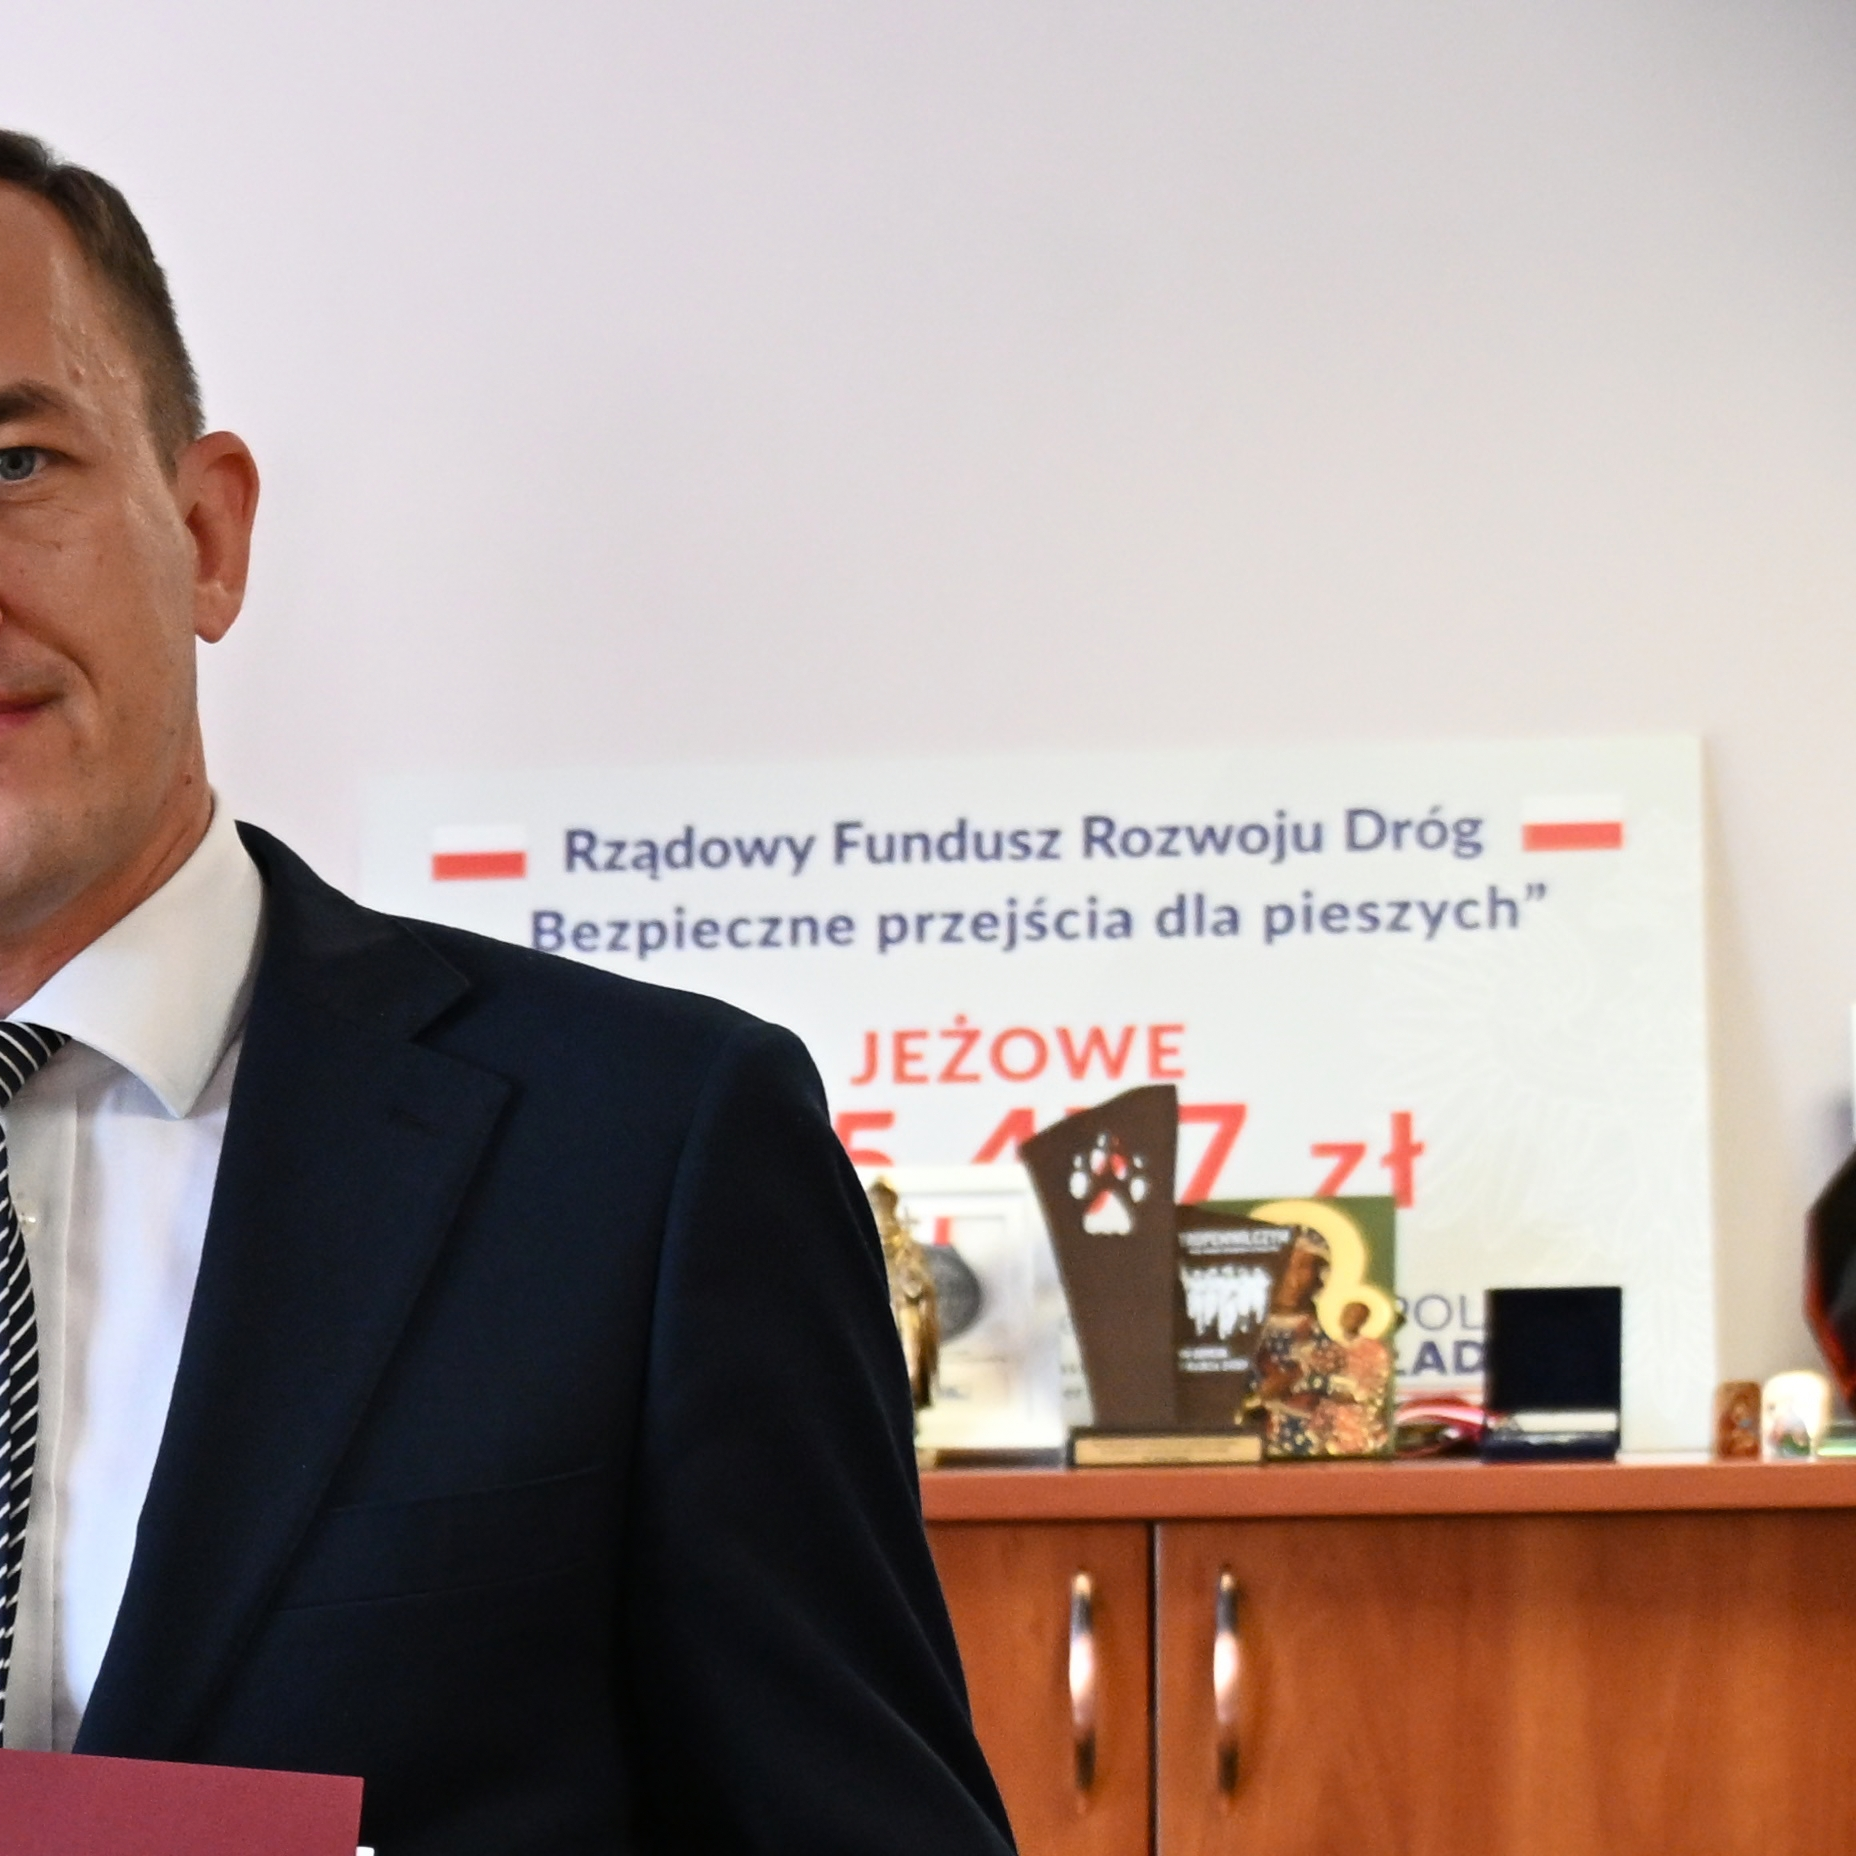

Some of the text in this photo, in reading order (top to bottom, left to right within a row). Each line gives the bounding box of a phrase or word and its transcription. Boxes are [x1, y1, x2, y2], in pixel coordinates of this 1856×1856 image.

[563, 804, 1485, 880] Rządowy Fundusz Rozwoju Dróg
[531, 905, 856, 960] Bezpieczne
[877, 896, 1134, 954] przejścia
[1155, 893, 1240, 938] dla
[849, 1012, 1187, 1086] JEŻOWE
[1309, 1110, 1426, 1210] zł
